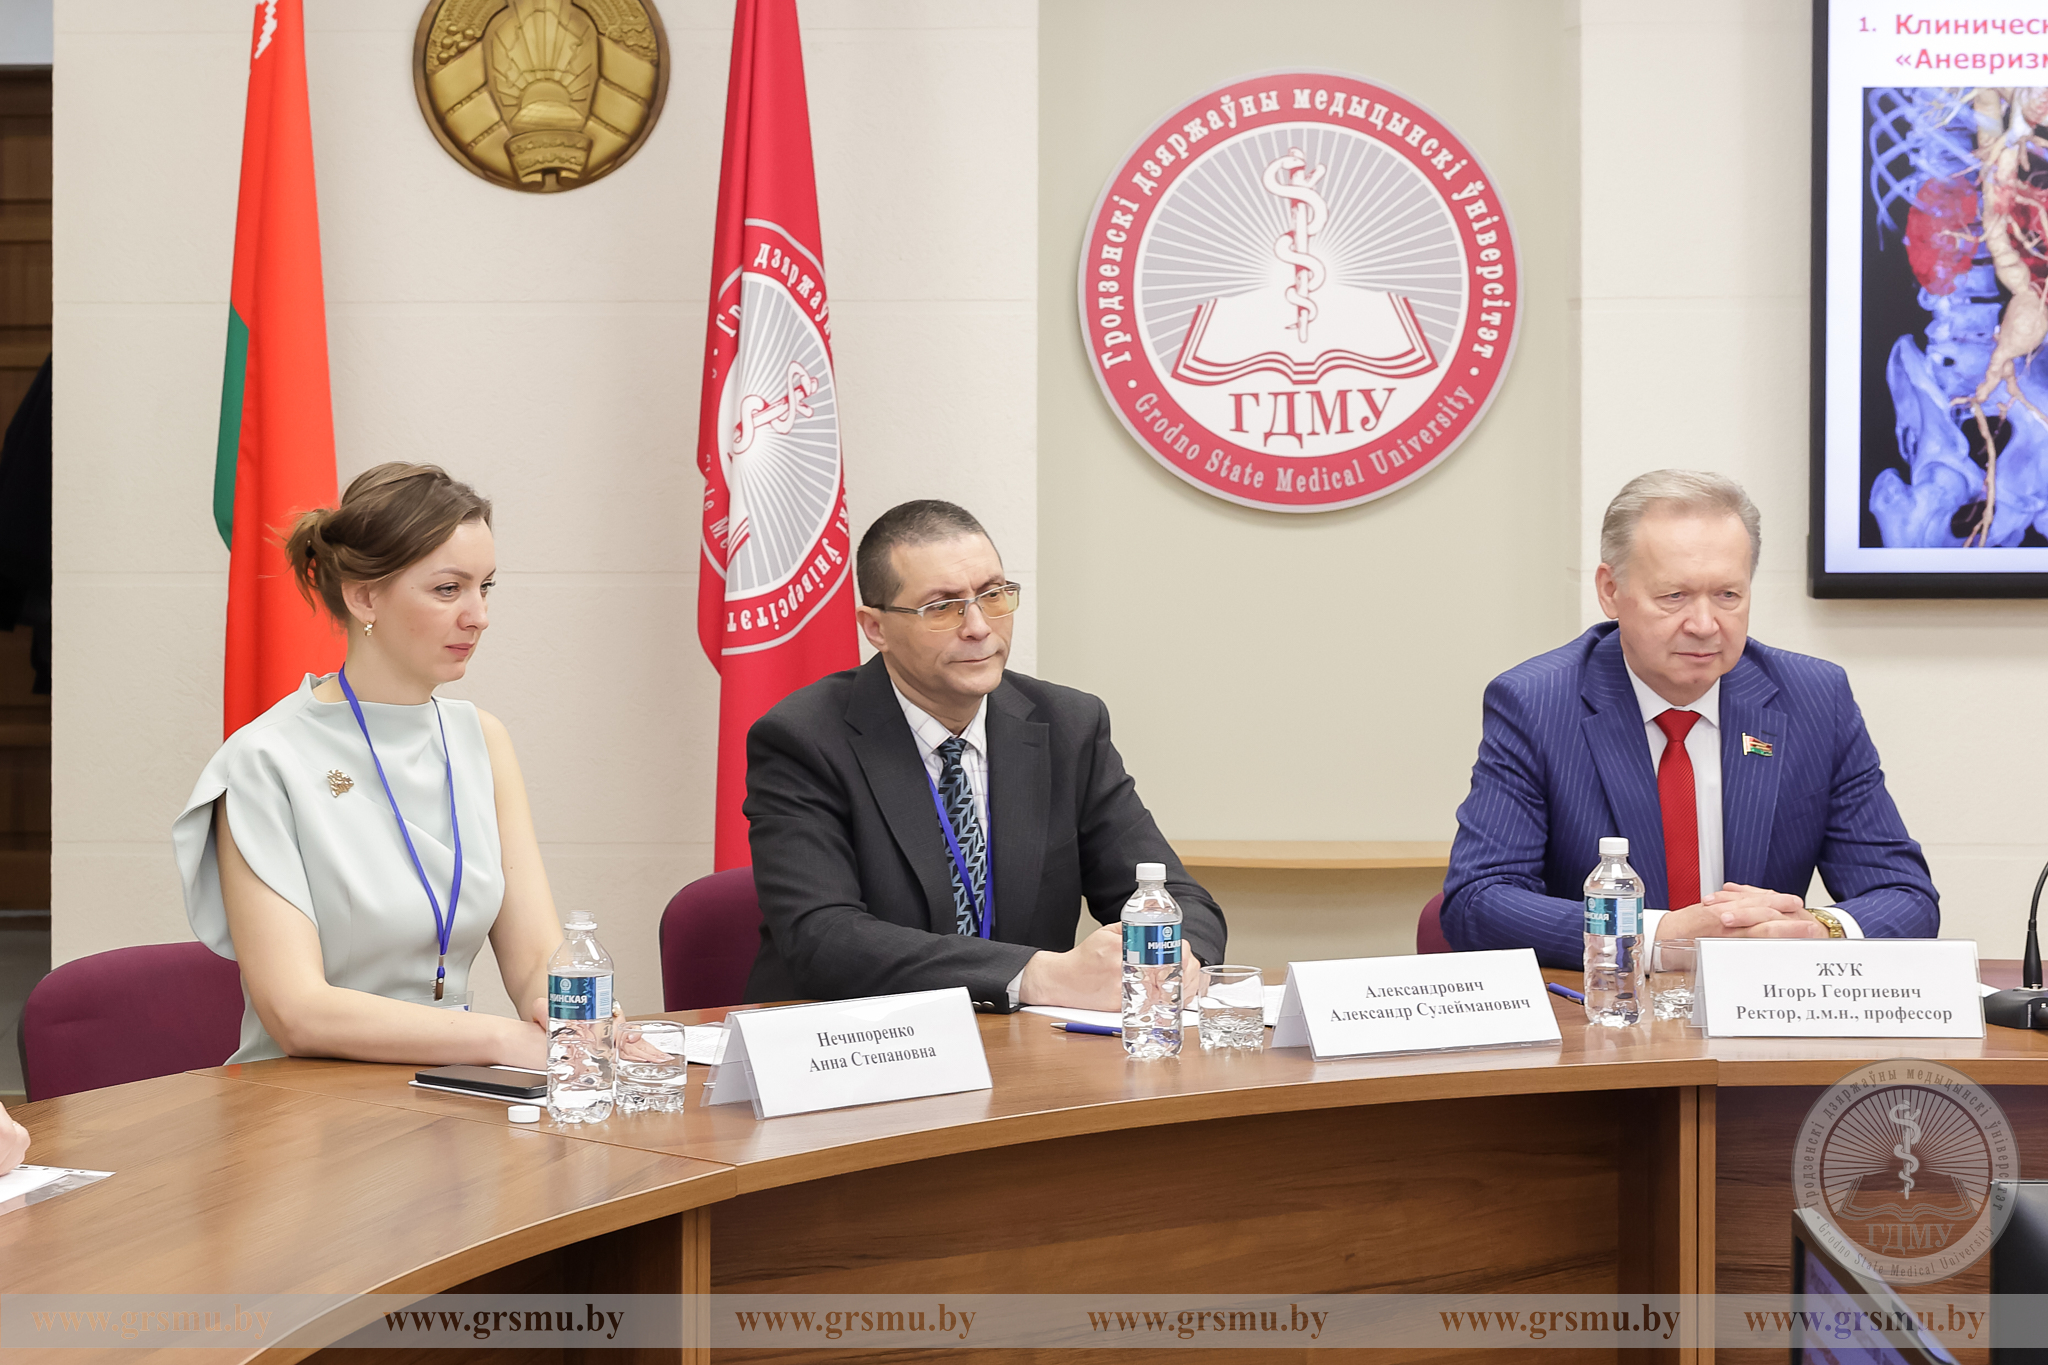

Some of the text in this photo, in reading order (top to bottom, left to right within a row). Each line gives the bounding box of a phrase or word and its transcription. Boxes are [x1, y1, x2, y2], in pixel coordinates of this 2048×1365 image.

[1859, 17, 1876, 32] 1.
[1098, 87, 1511, 369] Гродзенскі дзяржаўны медыцынскі ўніверсітэт
[1228, 387, 1397, 448] ГДМУ
[1135, 384, 1475, 493] Grodno State Medical University
[1816, 962, 1863, 977] ЖУК
[1365, 981, 1485, 999] Александрович
[1763, 983, 1921, 1001] Игорь Георгиевич
[1330, 998, 1531, 1022] Александр Сулейманович
[1736, 1005, 1953, 1023] Ректор, д.м.н., профессор
[817, 1025, 915, 1048] Нечипоренко
[809, 1046, 937, 1073] Анна Степановна
